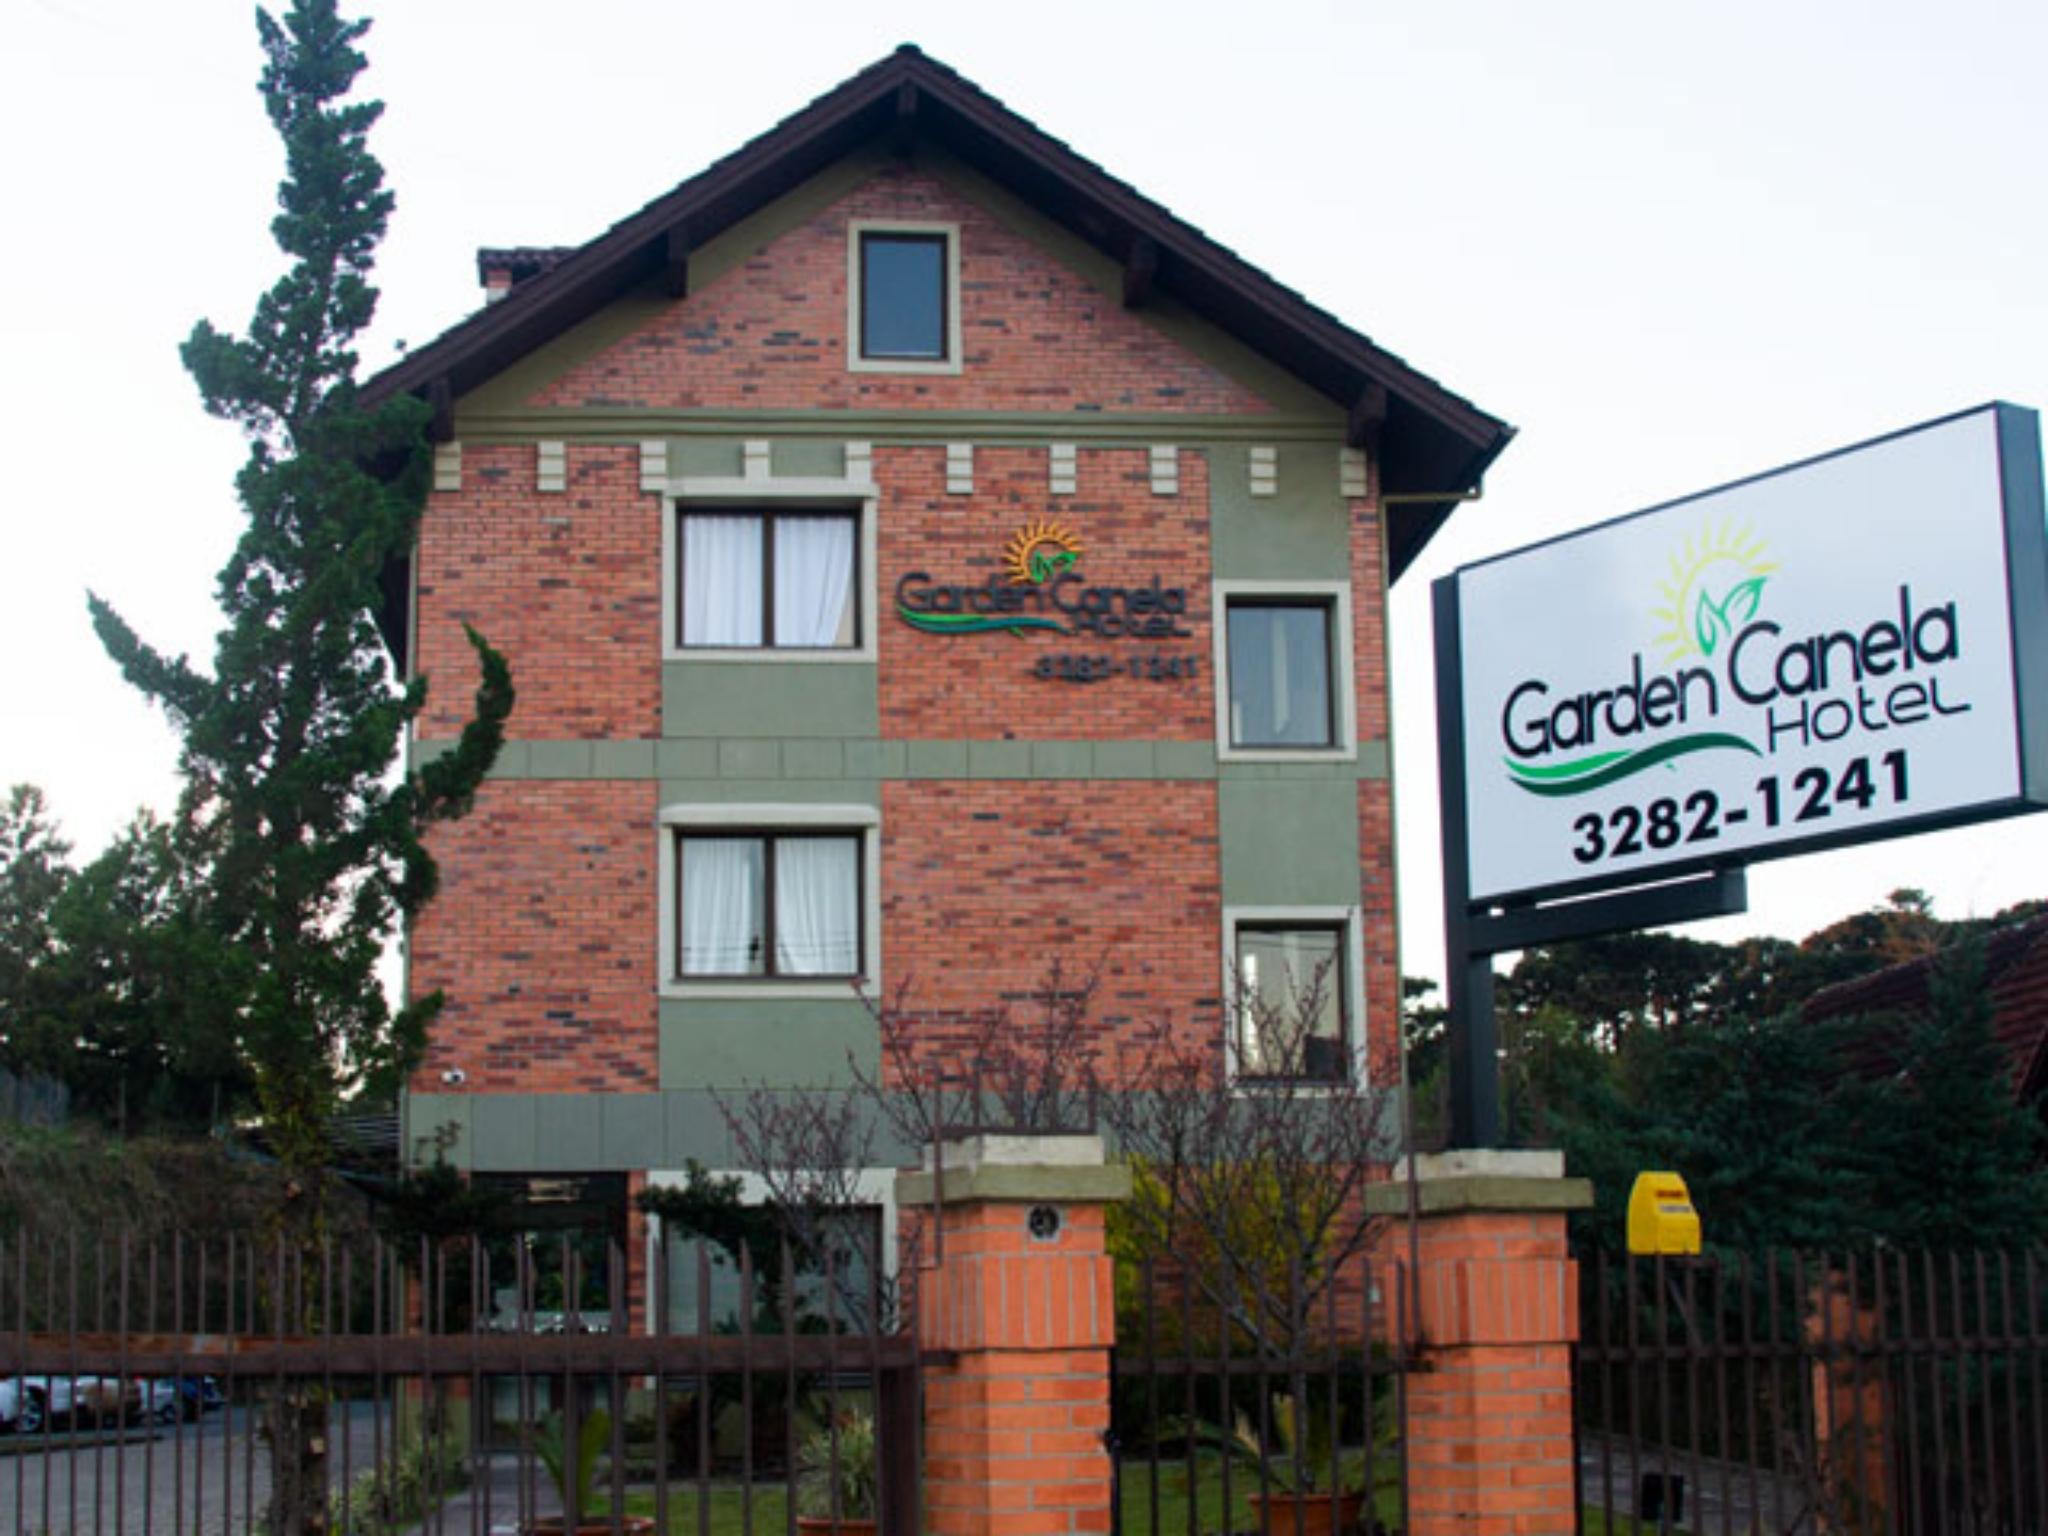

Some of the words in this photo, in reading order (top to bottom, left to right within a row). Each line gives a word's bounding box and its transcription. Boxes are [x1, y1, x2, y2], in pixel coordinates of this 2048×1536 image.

[896, 571, 1044, 612] Garden
[1049, 572, 1186, 614] Canela
[1502, 652, 1719, 759] Garden
[1727, 584, 1960, 705] Canela
[1572, 748, 1910, 865] 3282-1241
